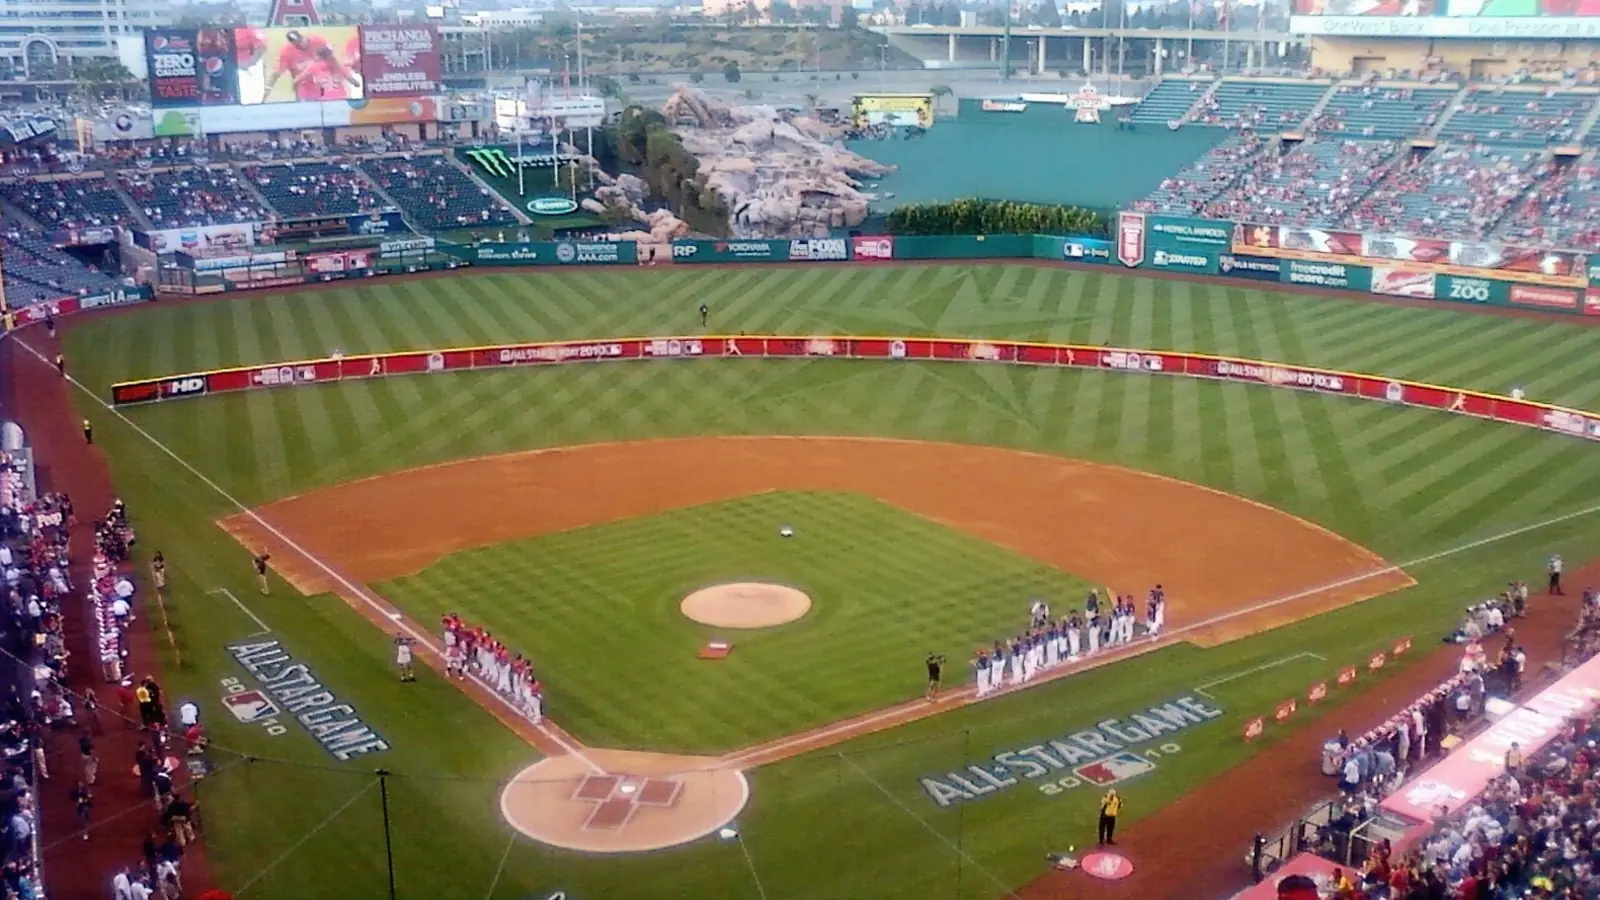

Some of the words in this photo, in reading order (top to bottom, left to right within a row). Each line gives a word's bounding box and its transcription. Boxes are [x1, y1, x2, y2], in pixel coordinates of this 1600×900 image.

[365, 30, 431, 41] PECHANGA
[153, 54, 195, 69] ZERO
[158, 85, 196, 97] TASTE
[368, 81, 435, 91] POSSIBILITIES
[674, 246, 697, 256] RP
[728, 243, 771, 252] YOKOHAMA
[577, 253, 618, 261] AAA.com
[1450, 284, 1488, 301] ZOO
[172, 379, 204, 393] HD
[1097, 695, 1224, 744] GAME
[297, 703, 392, 761] GAME
[1039, 775, 1082, 796] 20
